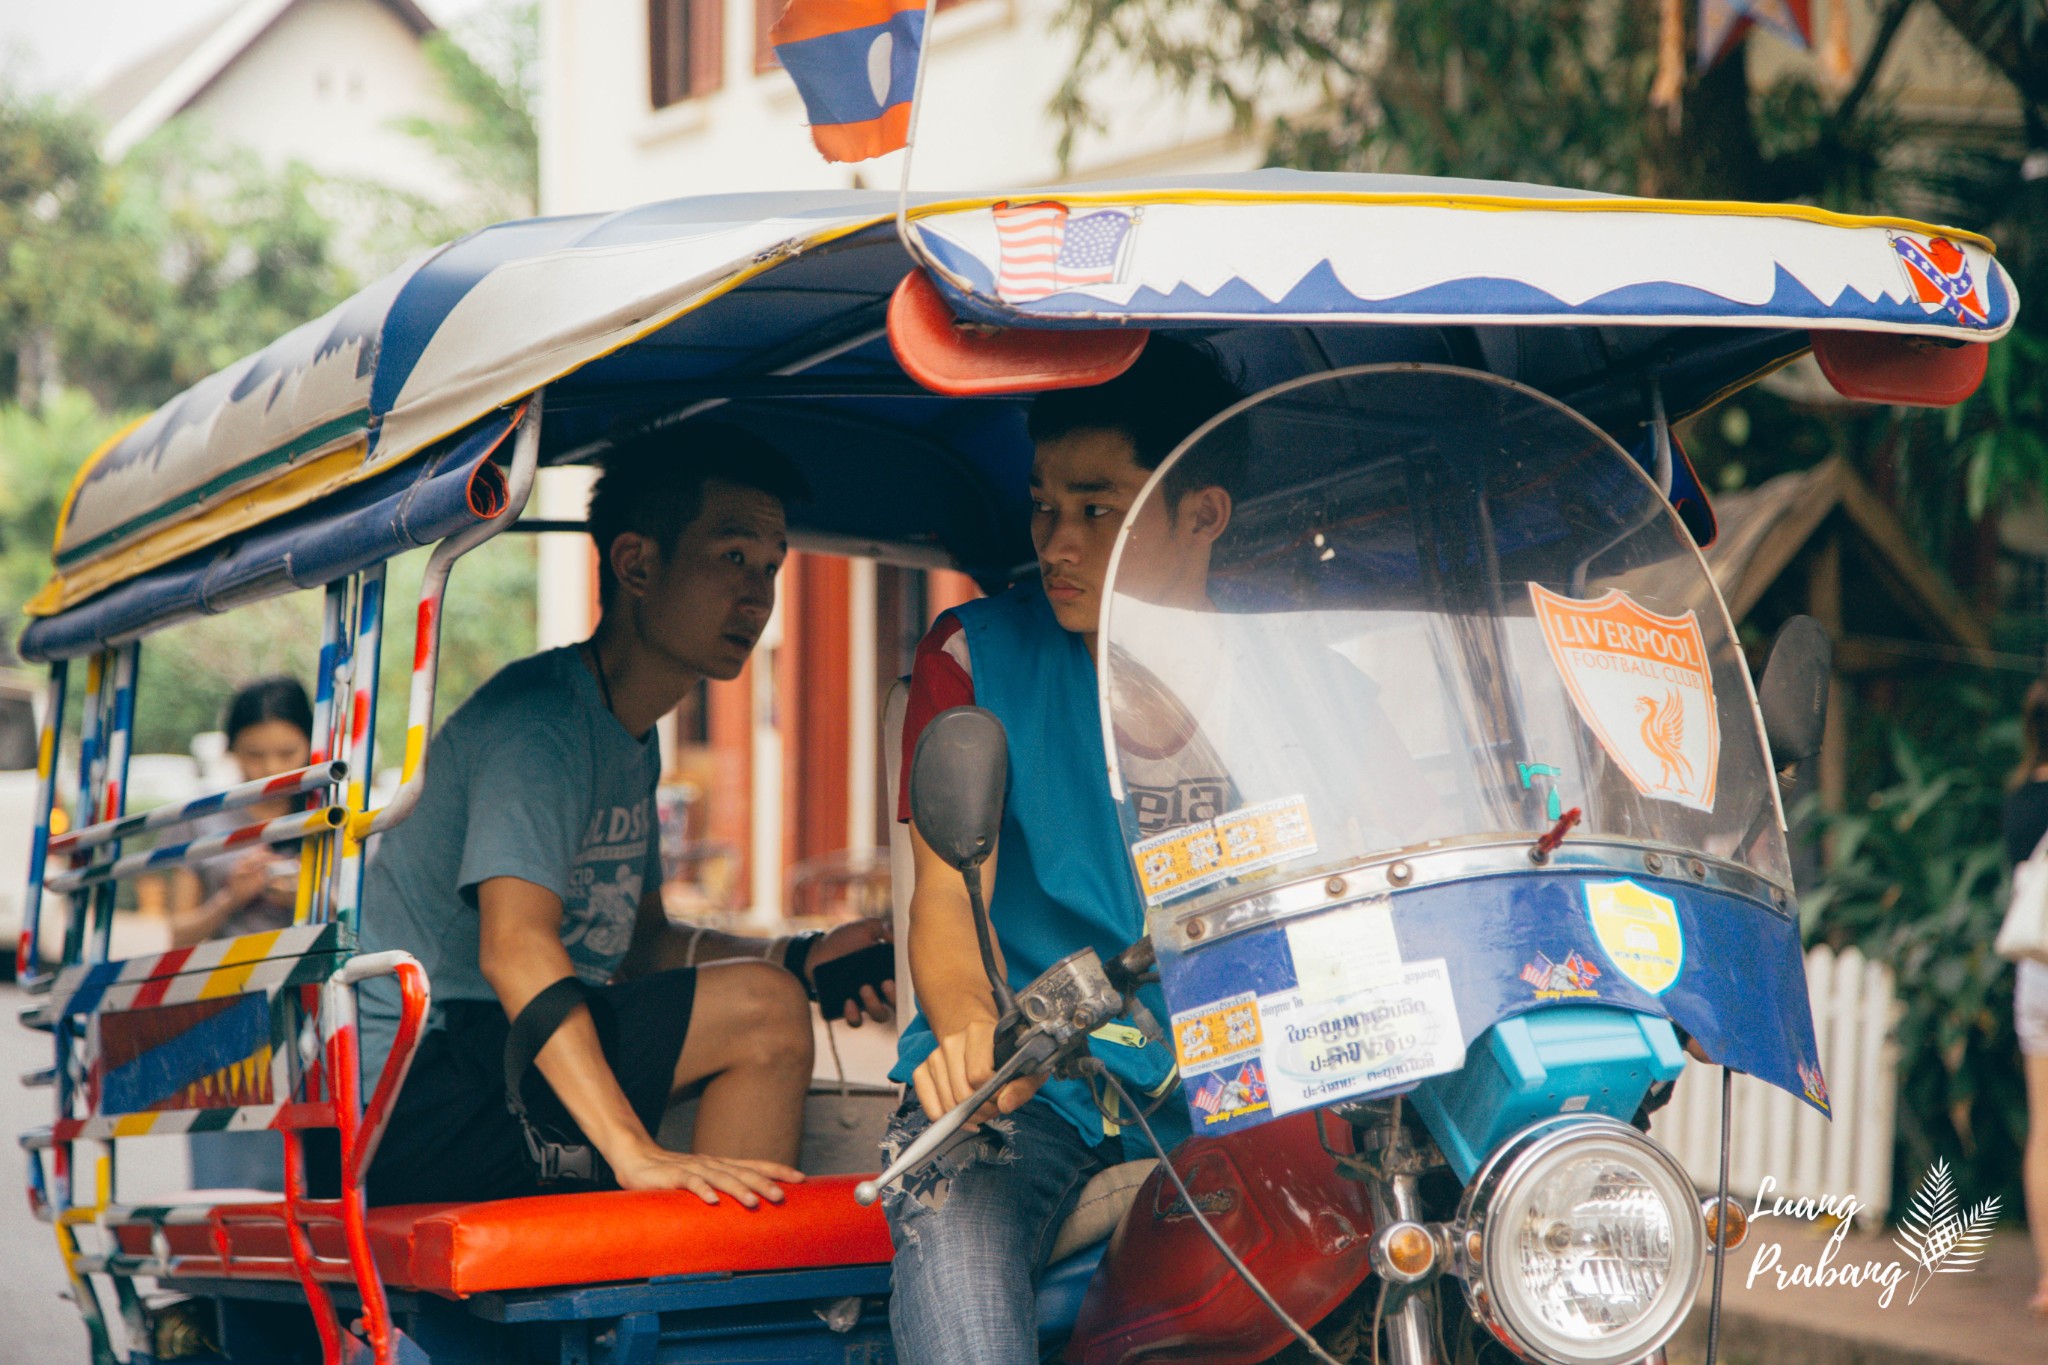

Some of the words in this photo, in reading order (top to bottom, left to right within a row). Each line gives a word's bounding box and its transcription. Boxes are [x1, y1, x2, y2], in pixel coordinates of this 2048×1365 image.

[1554, 614, 1700, 667] LIVERPOOL
[1571, 652, 1660, 680] FOOTBALL
[1663, 666, 1701, 690] CLUB
[1169, 845, 1175, 854] 3
[1181, 841, 1187, 849] 4
[1165, 876, 1171, 886] 8
[1176, 873, 1183, 882] 9
[1186, 868, 1197, 877] 10
[1199, 863, 1208, 873] 11
[1153, 885, 1187, 901] TECHNICAL
[1207, 1017, 1213, 1026] 3
[1219, 1014, 1225, 1022] 4
[1231, 1010, 1237, 1019] 5
[1243, 1006, 1249, 1015] 6
[1200, 1050, 1206, 1059] 8
[1212, 1046, 1218, 1056] 9
[1222, 1042, 1232, 1052] 10
[1235, 1038, 1244, 1048] 11
[1247, 1034, 1257, 1044] 12
[1376, 1034, 1417, 1056] 2019
